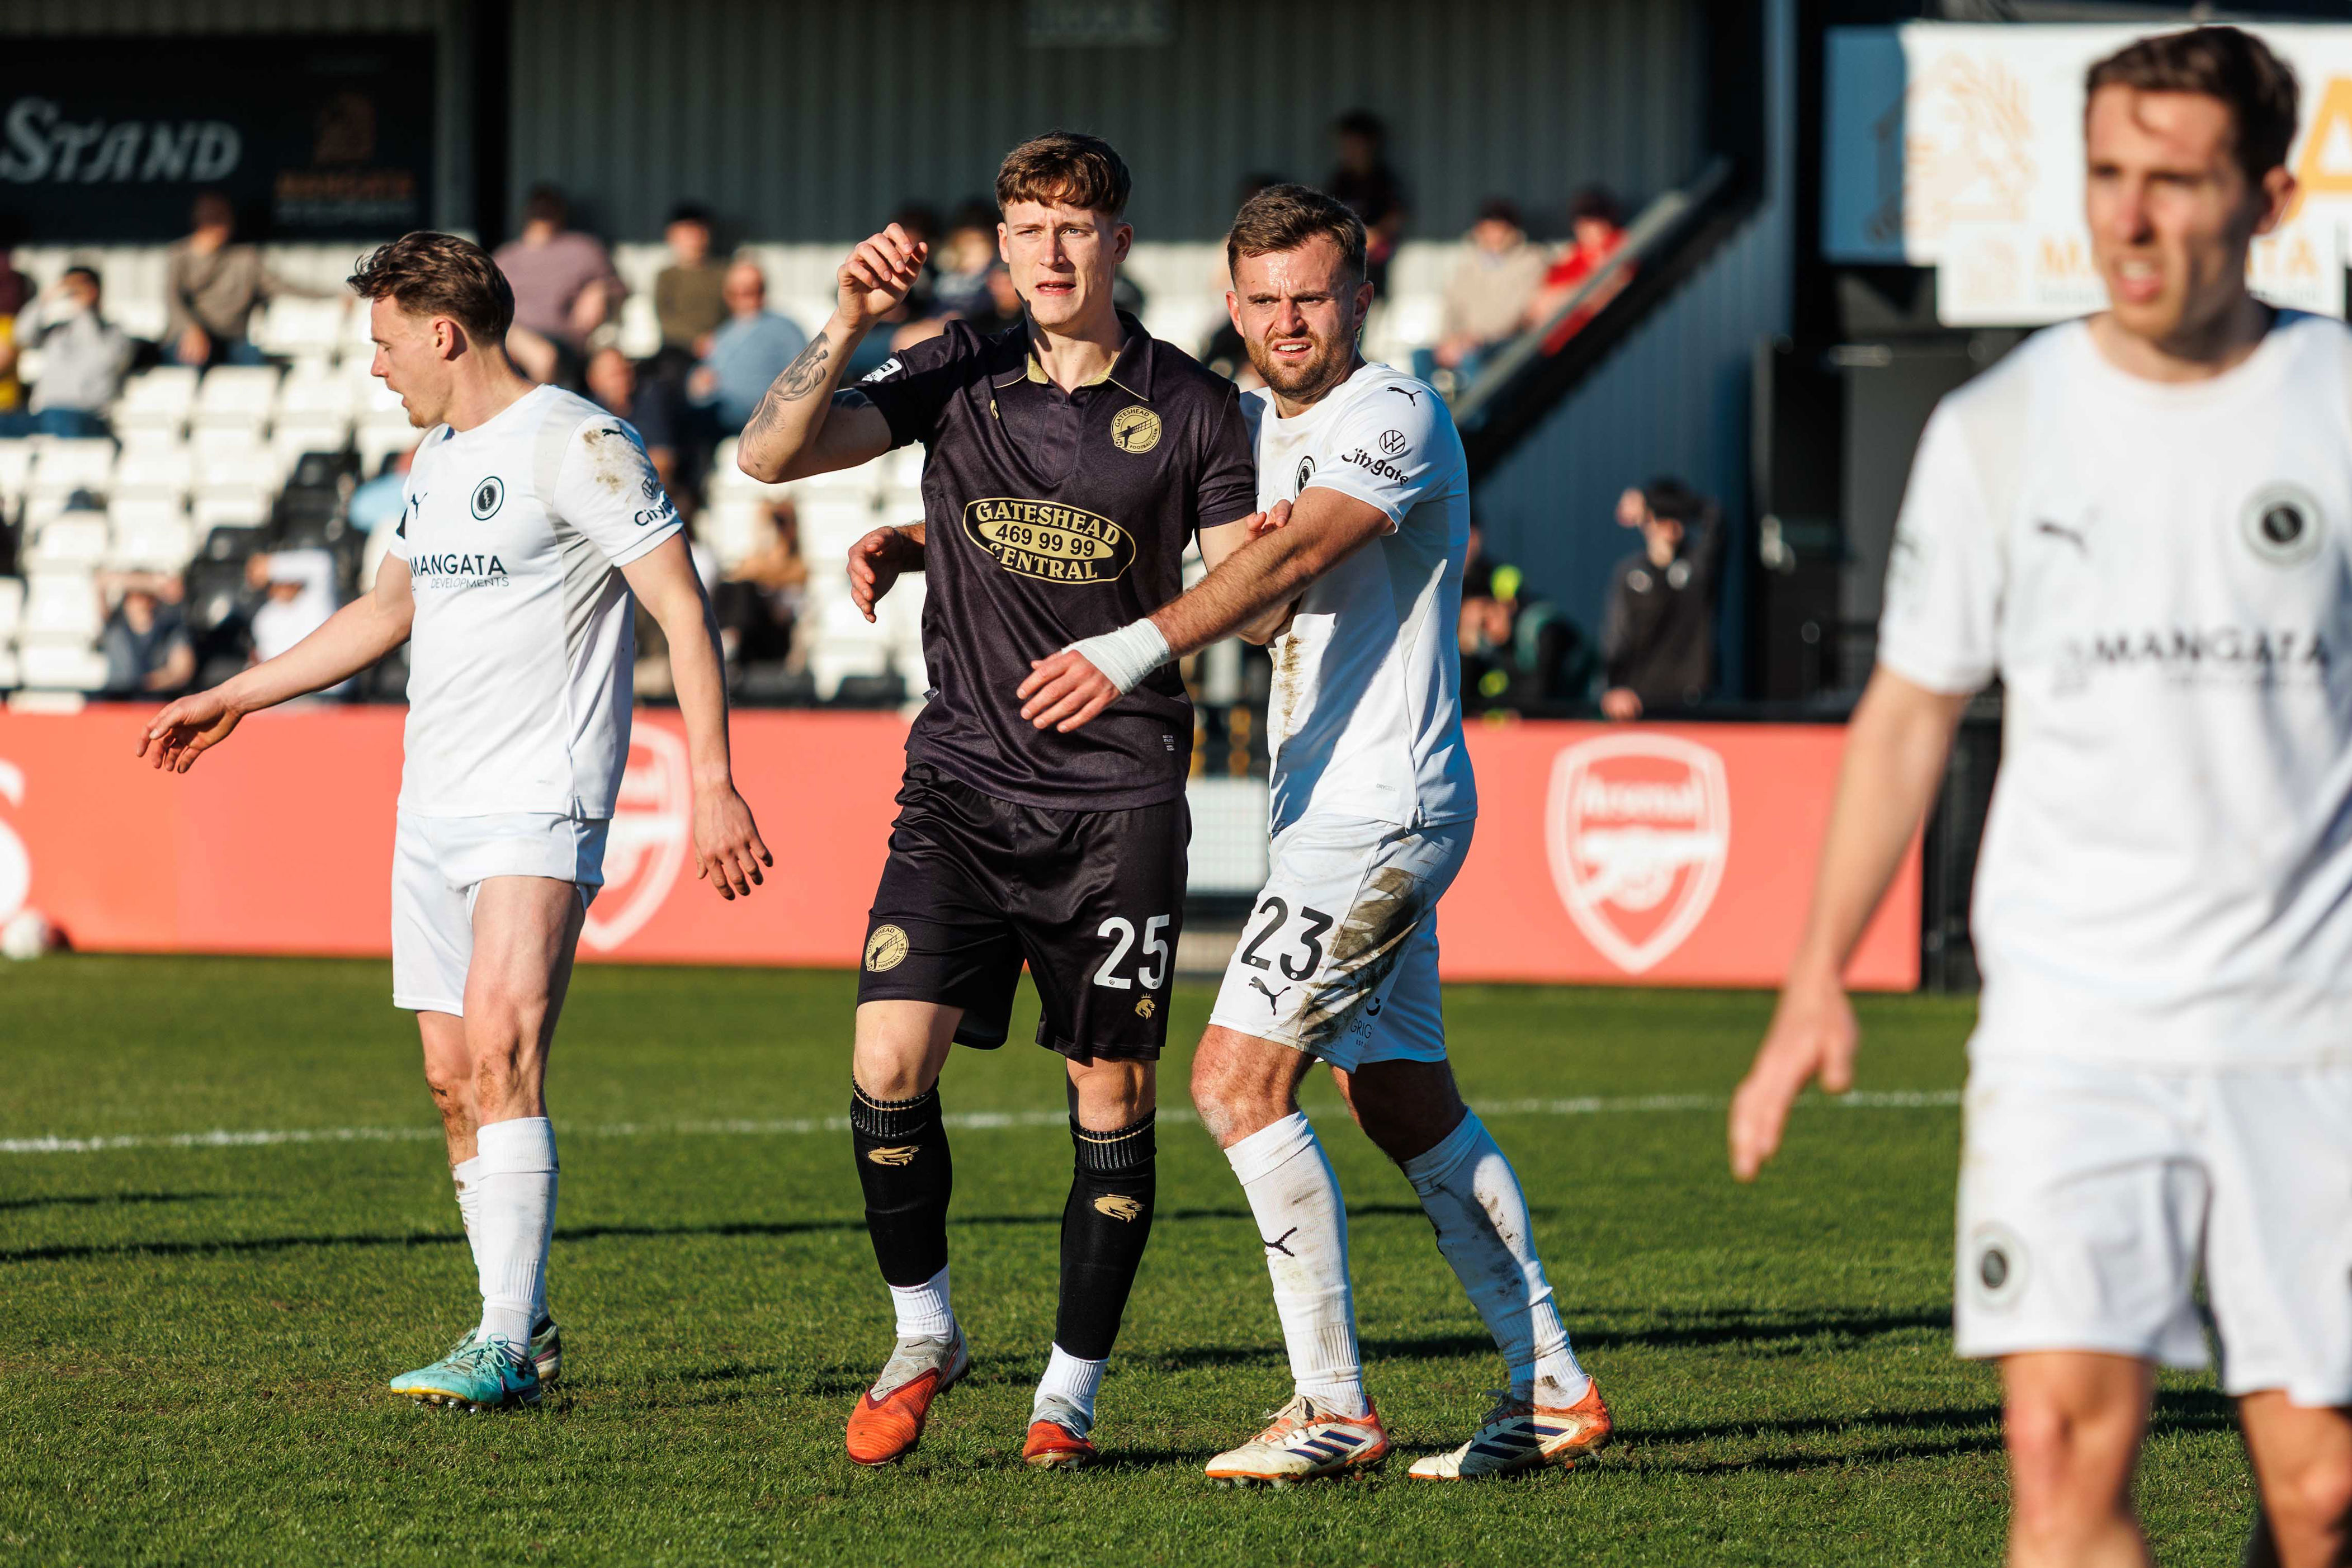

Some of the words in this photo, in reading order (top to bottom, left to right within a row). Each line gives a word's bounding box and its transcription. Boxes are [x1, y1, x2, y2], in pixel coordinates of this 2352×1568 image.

[1114, 408, 1150, 427] GATESHEAD
[1130, 441, 1153, 450] FOOTBALL
[1341, 448, 1409, 486] Citygate
[976, 502, 1121, 545] GATESHEAD
[995, 523, 1032, 545] 469
[1038, 532, 1064, 552] 99
[1070, 538, 1095, 558] 99
[410, 553, 508, 578] MANGATA
[989, 542, 1098, 579] CENTRAL
[431, 576, 509, 589] DEVELOPMENTS
[1094, 914, 1170, 990] 25
[1241, 896, 1334, 981] 23
[1350, 1018, 1373, 1039] GRIG
